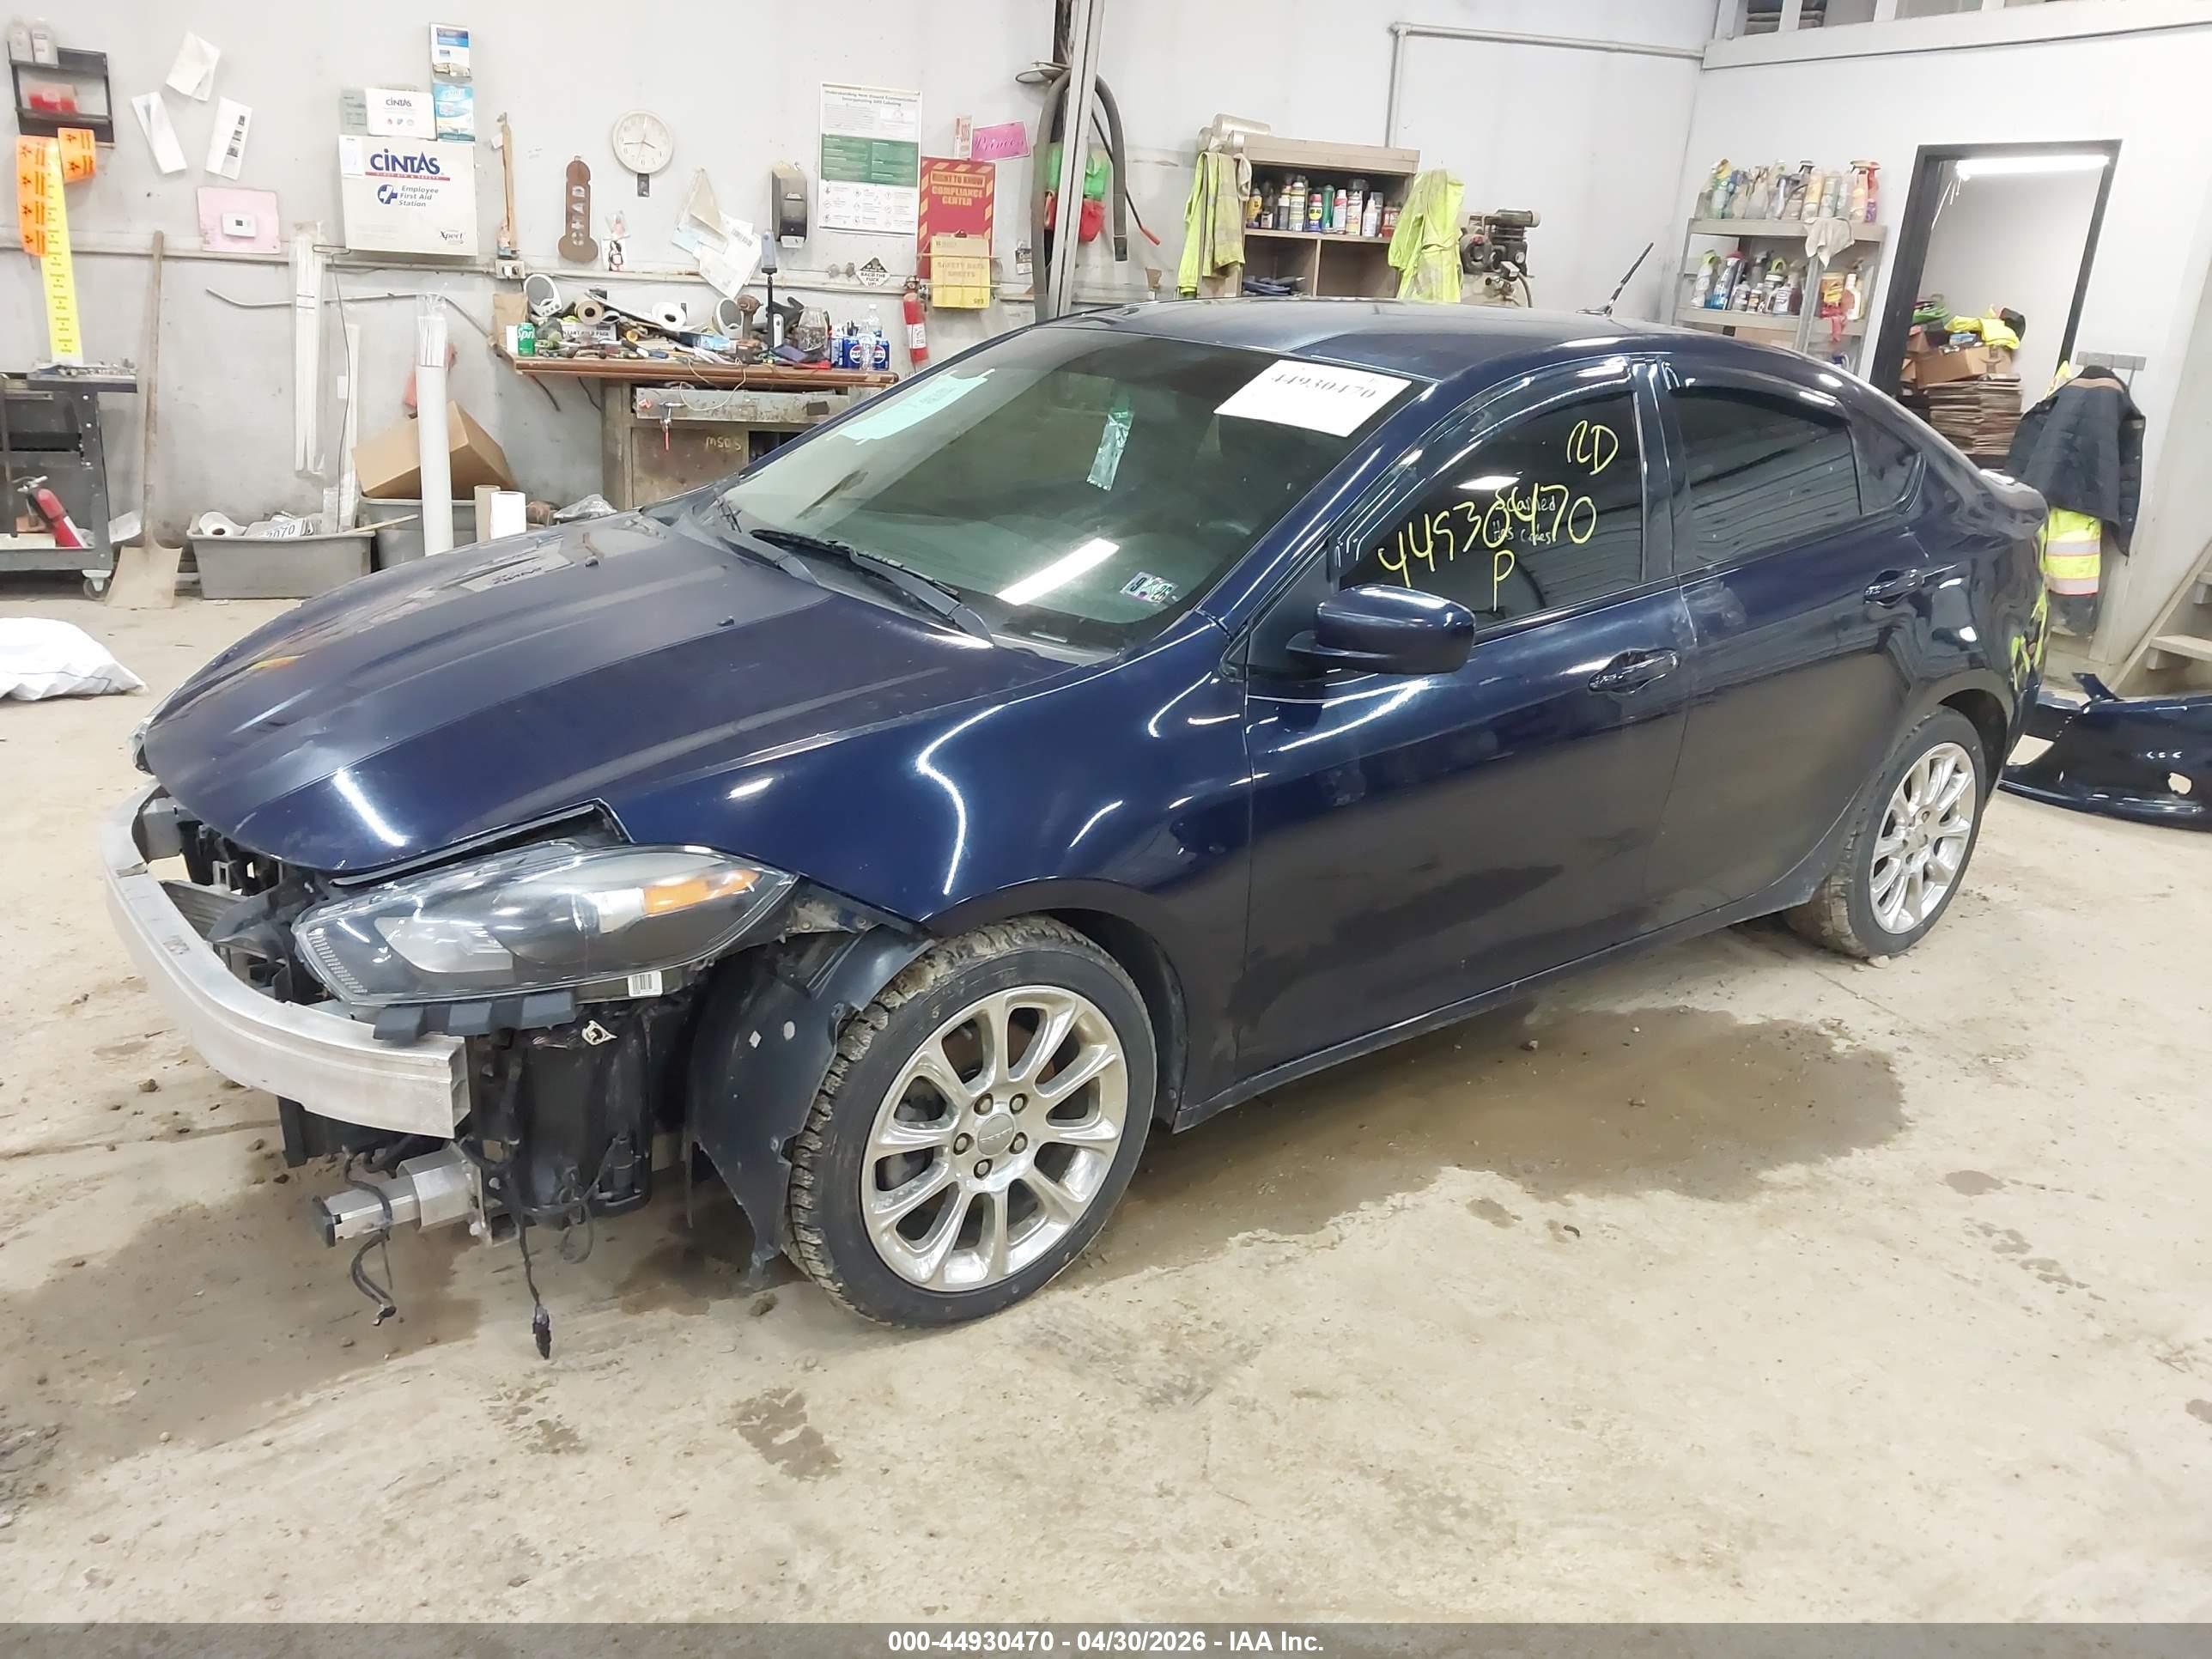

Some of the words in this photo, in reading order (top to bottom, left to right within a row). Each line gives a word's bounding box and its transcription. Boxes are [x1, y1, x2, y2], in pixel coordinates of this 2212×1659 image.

[401, 185, 440, 194] Employee
[932, 185, 983, 198] COMPLIANCE
[941, 196, 972, 206] CENTER
[1377, 482, 1597, 589] 44930470
[1492, 550, 1516, 612] P
